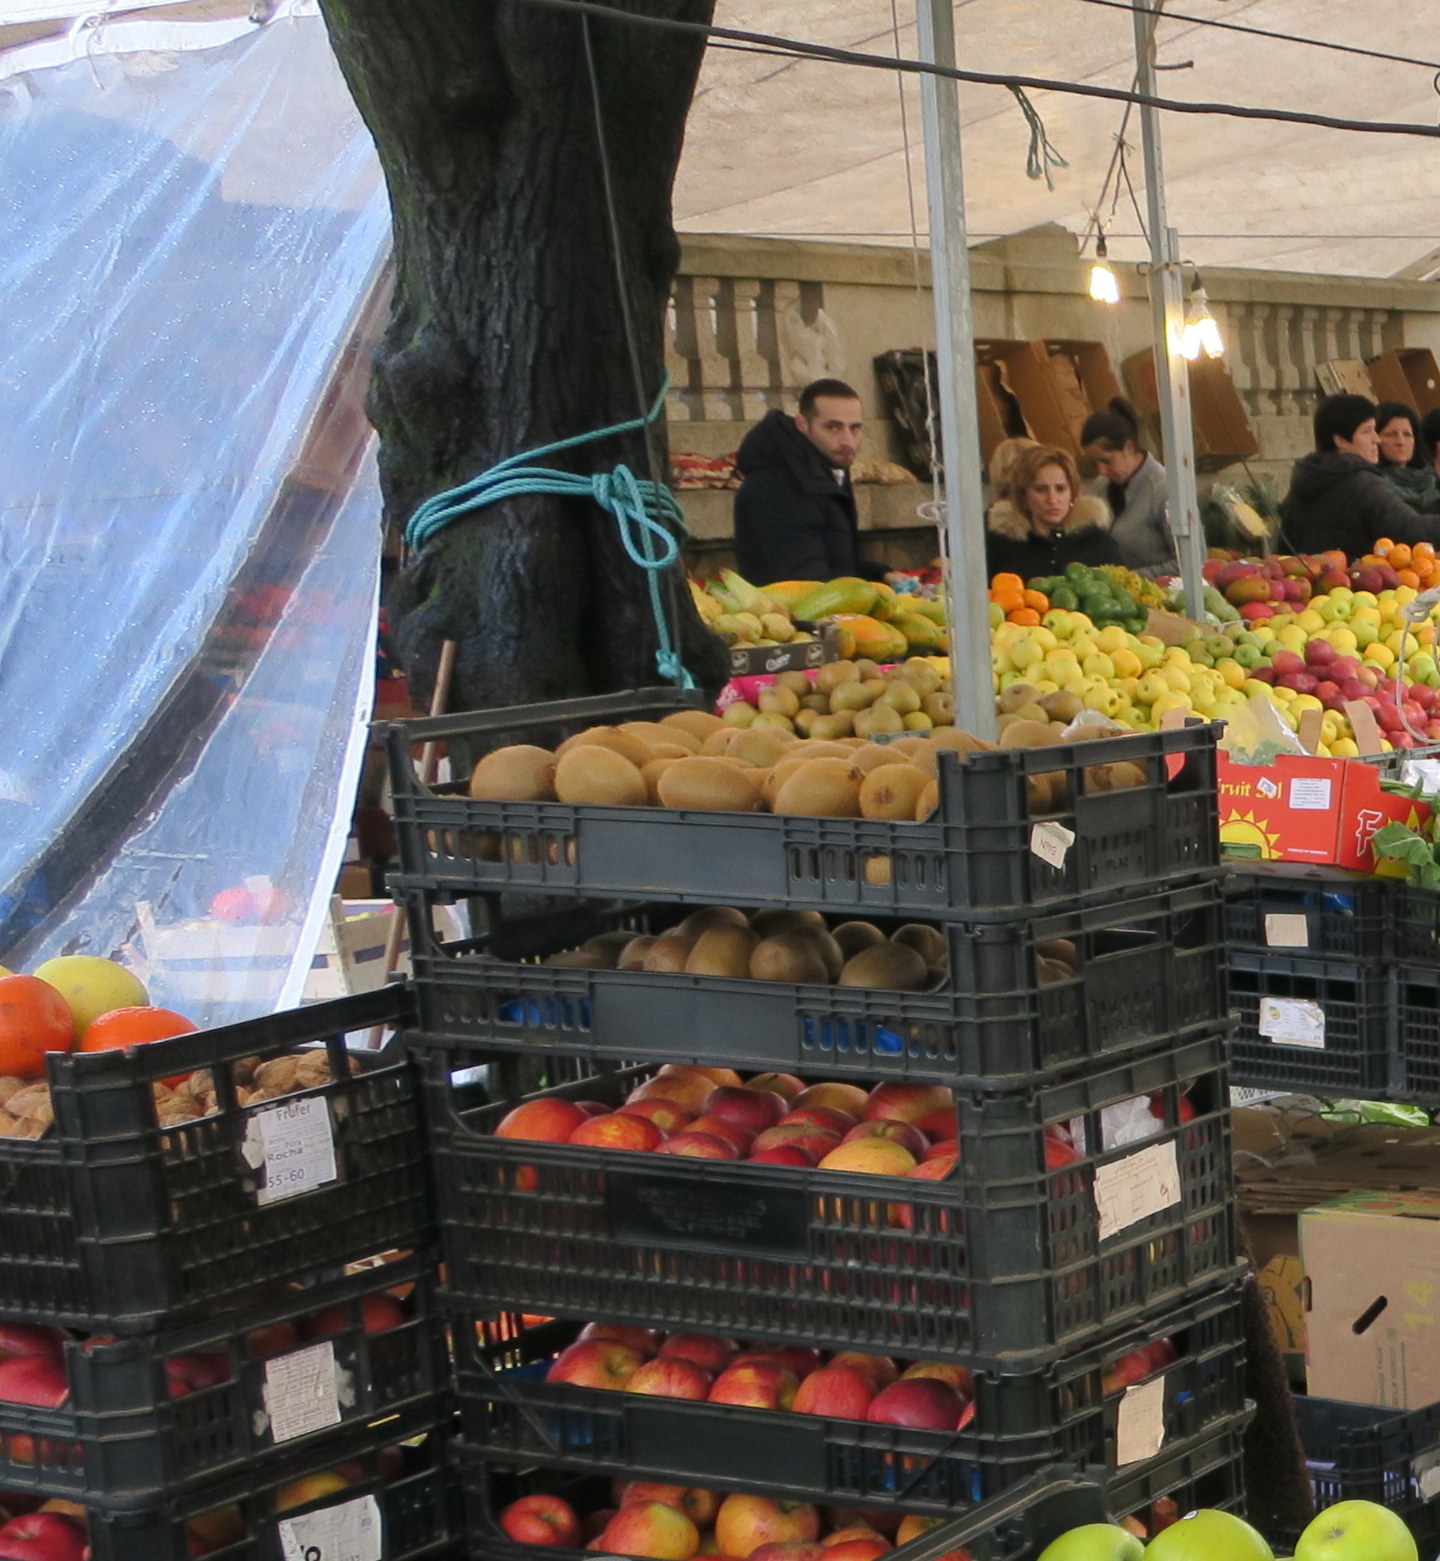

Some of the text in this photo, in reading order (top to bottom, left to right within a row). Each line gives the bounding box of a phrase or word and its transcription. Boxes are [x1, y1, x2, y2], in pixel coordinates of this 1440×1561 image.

[1218, 777, 1251, 797] ruit
[267, 1148, 303, 1162] Rocha
[268, 1169, 305, 1188] 55-60
